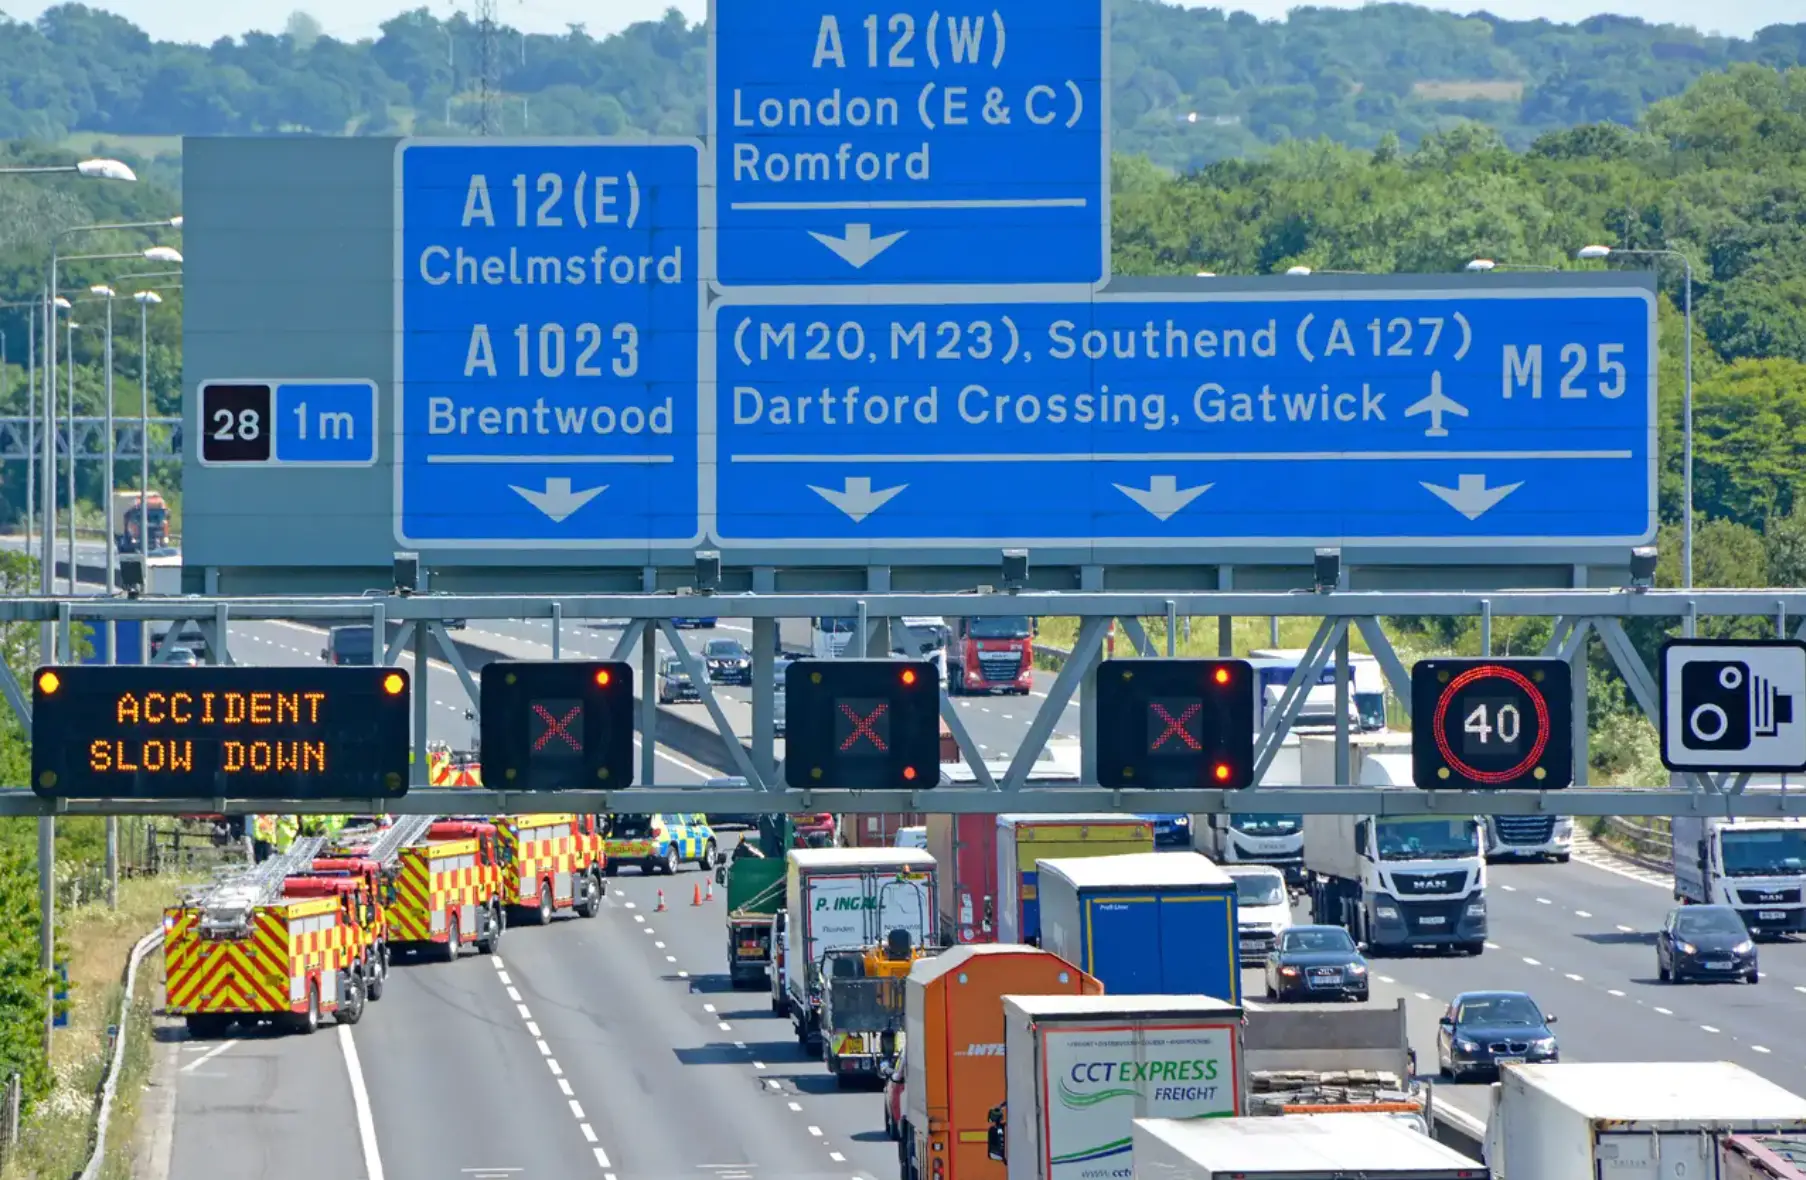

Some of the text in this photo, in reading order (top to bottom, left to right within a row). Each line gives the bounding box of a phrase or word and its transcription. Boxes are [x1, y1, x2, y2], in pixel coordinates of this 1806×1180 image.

[734, 88, 898, 127] London
[982, 87, 1011, 125] &
[734, 142, 929, 182] Romford
[420, 245, 682, 286] Chelmsford
[734, 316, 877, 365] (M20,
[891, 315, 1032, 365] M23),
[1049, 319, 1276, 359] Southend
[213, 407, 260, 441] 28
[429, 397, 673, 434] Brentwood
[734, 383, 1386, 430] Dartford Crossing, Gatwick
[117, 691, 325, 724] ACCIDENT
[1463, 703, 1521, 744] 40
[90, 739, 325, 772] SLOW DOWN
[1070, 1059, 1219, 1083] CCT EXPRESS
[1154, 1086, 1219, 1101] FREIGHT
